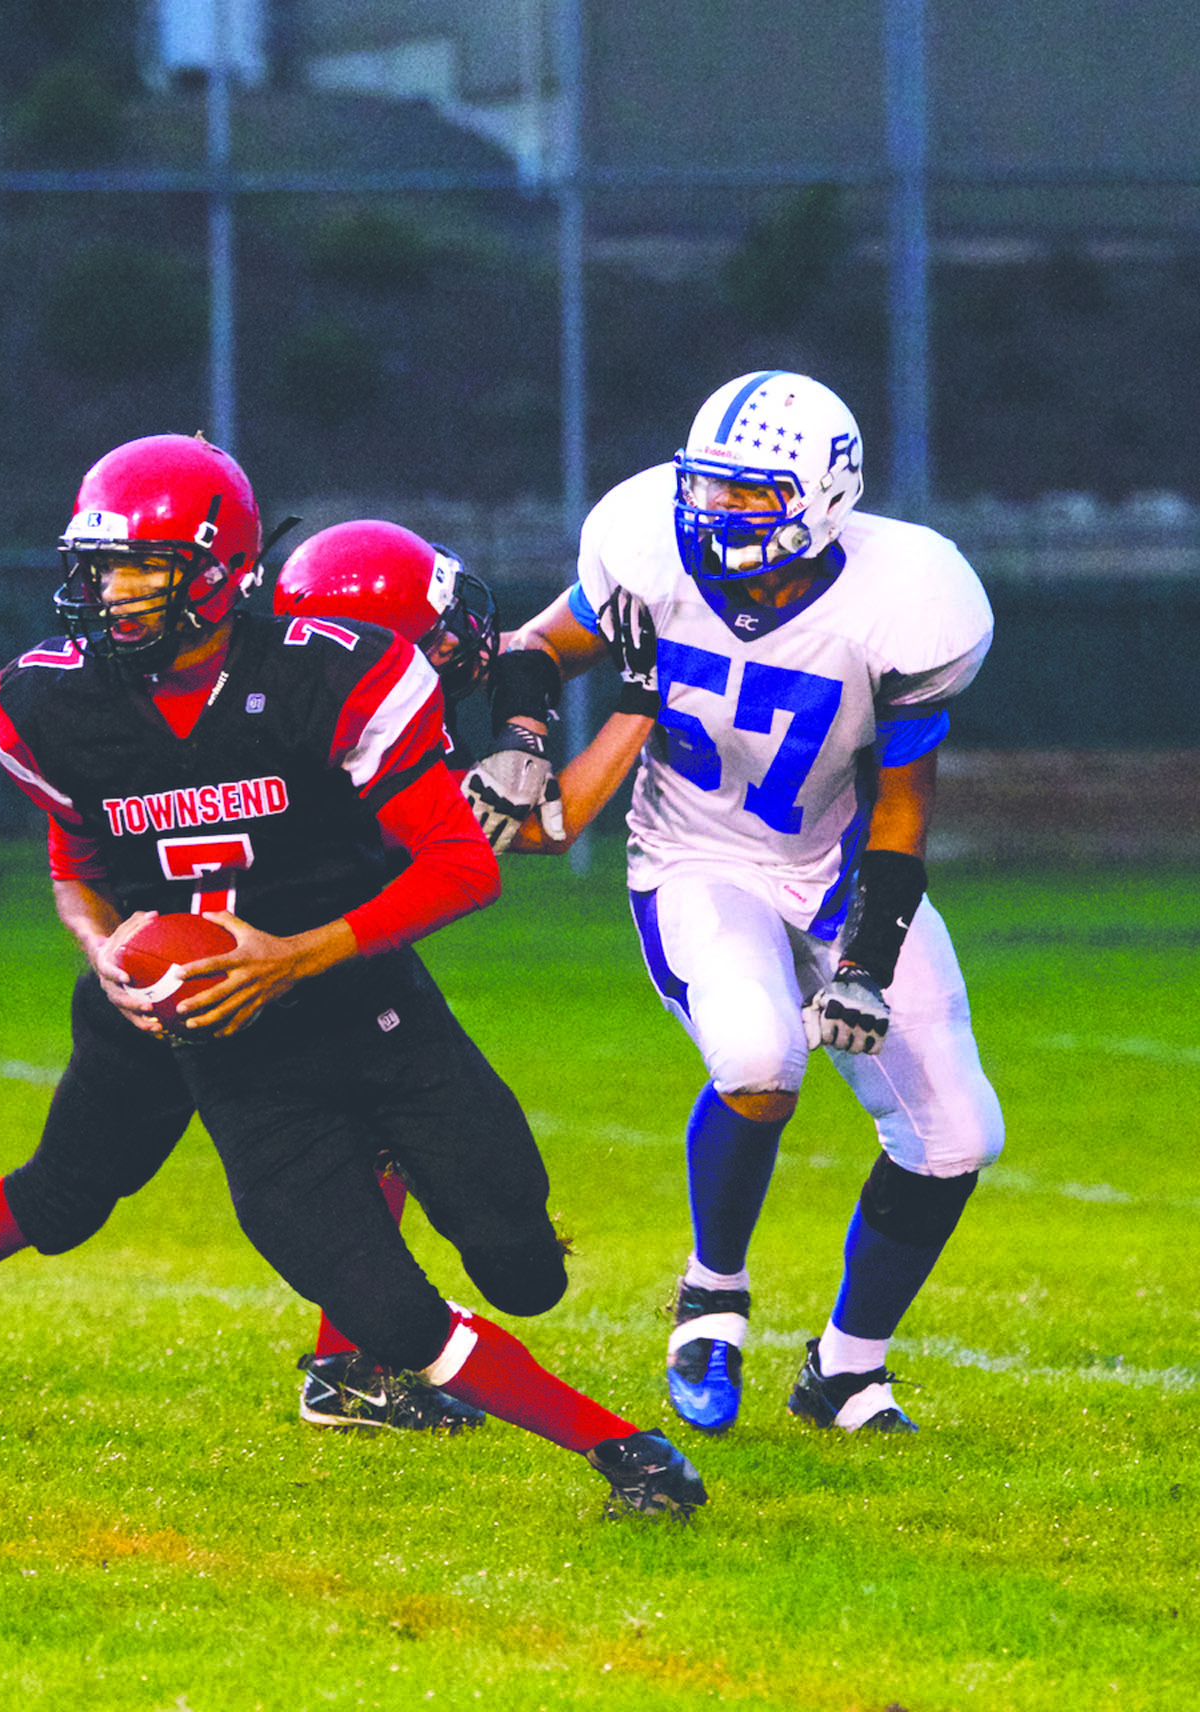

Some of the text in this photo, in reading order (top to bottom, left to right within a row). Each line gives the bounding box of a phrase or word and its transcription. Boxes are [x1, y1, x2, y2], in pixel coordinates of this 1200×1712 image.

[284, 616, 361, 651] 7
[656, 637, 843, 835] 57
[103, 775, 289, 837] TOWNSEND
[156, 833, 255, 915] 7
